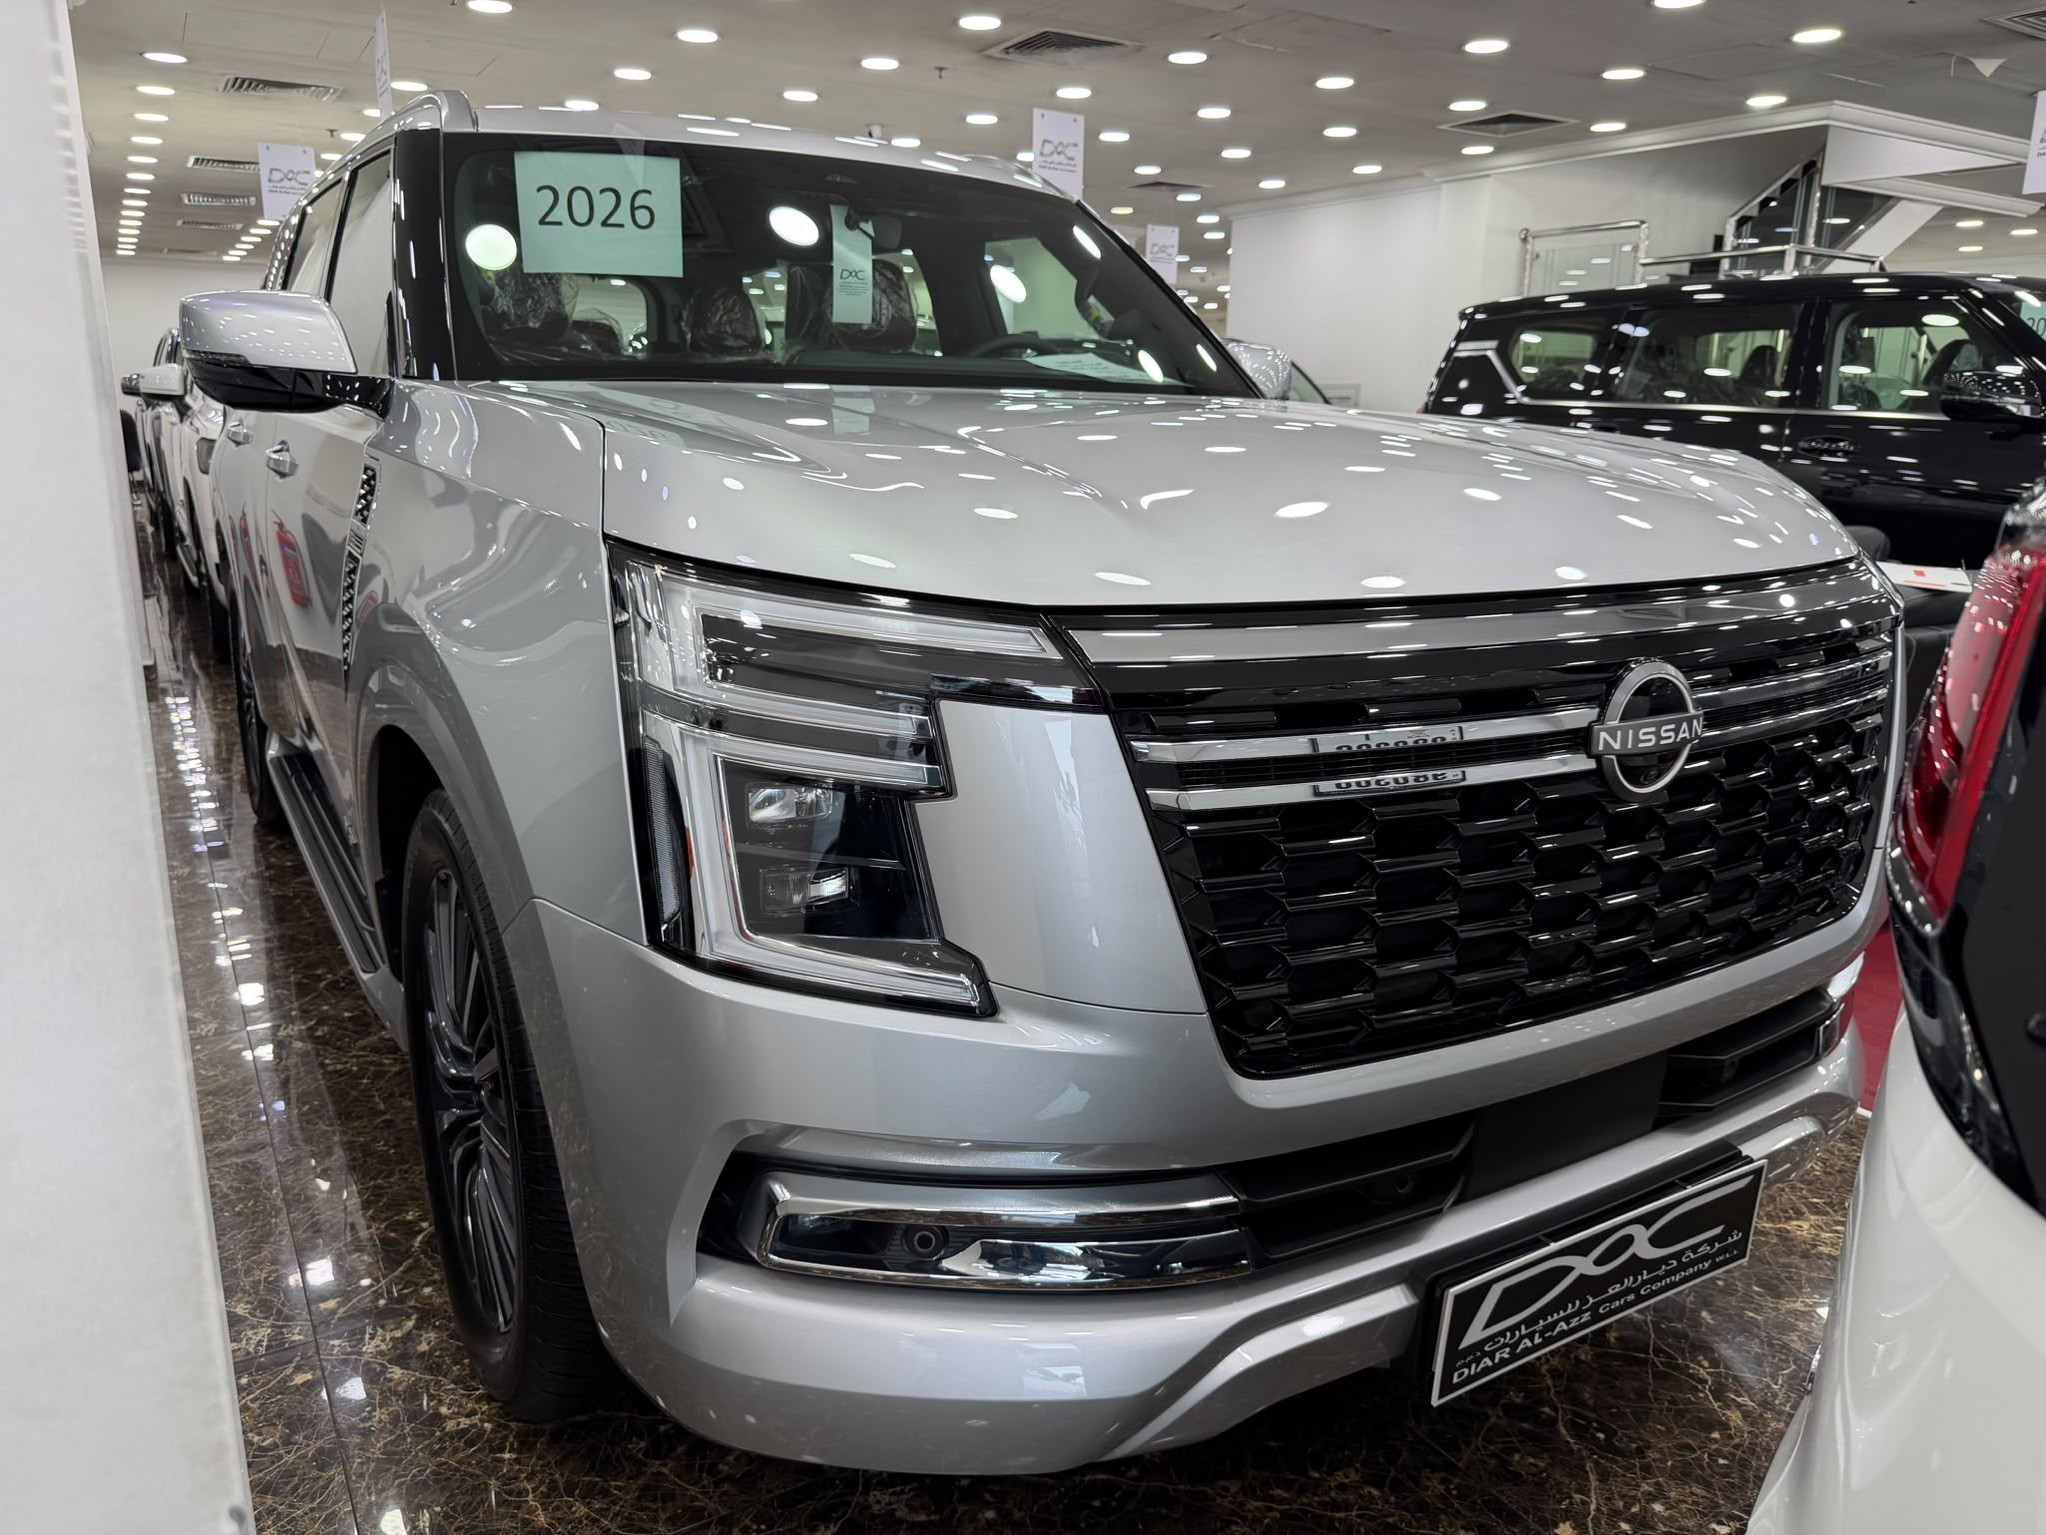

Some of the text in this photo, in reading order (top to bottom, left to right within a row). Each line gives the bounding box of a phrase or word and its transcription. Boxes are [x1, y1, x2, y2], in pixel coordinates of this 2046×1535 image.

[536, 184, 656, 230] 2026
[1598, 716, 1703, 751] NISSAN
[1681, 1229, 1743, 1263] شركة
[1452, 1347, 1511, 1385] DIAR
[1598, 1293, 1636, 1314] Cars
[1639, 1259, 1712, 1296] Company
[1483, 1299, 1580, 1351] للسيارات
